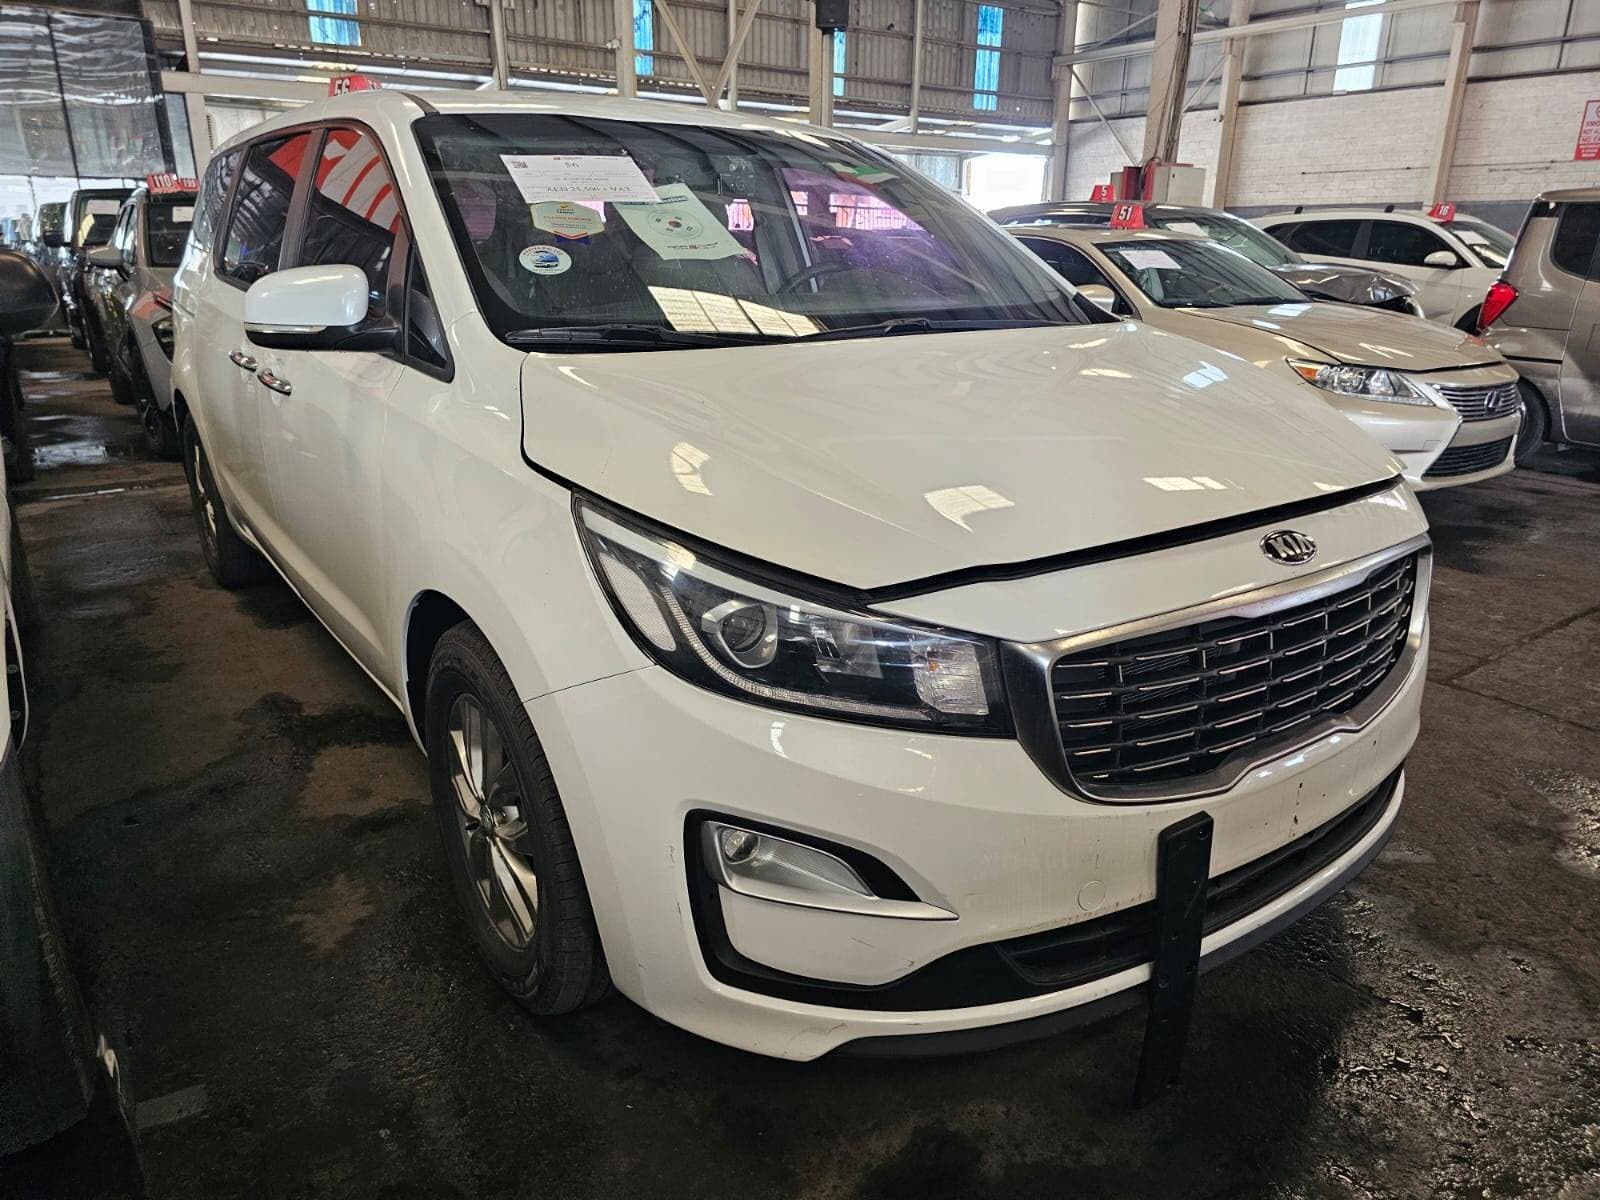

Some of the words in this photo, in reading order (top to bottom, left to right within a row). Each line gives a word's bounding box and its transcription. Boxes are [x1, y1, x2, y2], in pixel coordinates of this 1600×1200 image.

[334, 79, 350, 97] 56
[563, 158, 580, 168] 56
[153, 174, 172, 188] 110
[1101, 185, 1108, 197] 5
[1119, 205, 1133, 221] 51
